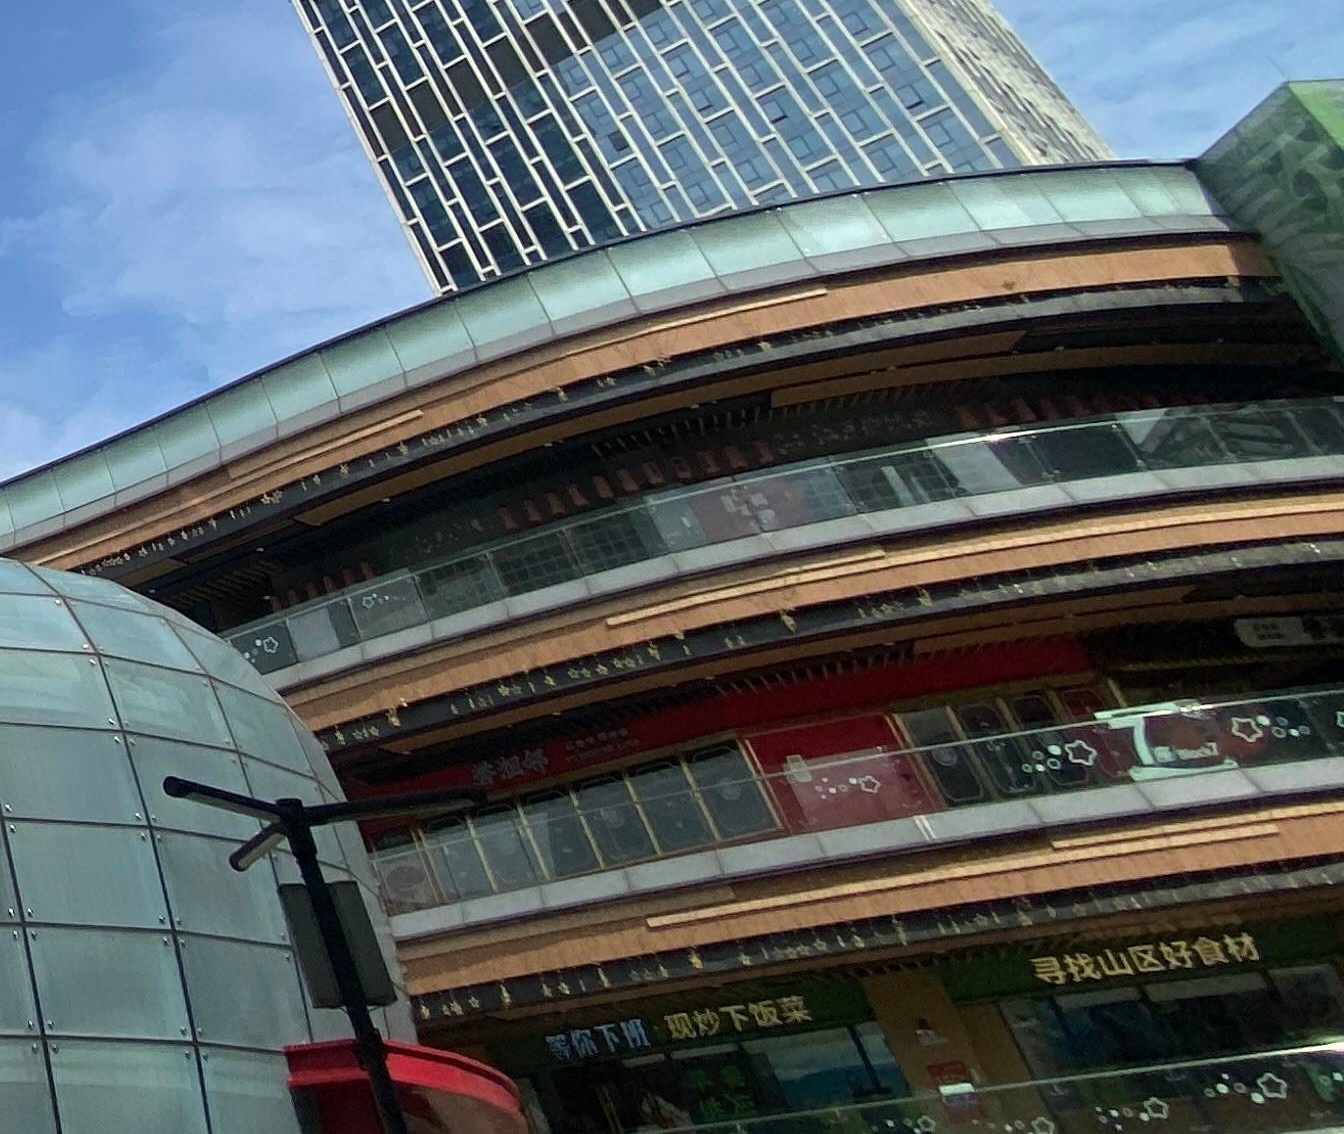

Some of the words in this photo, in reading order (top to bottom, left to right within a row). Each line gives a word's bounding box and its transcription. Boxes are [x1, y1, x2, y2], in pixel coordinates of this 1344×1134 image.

[1028, 930, 1260, 986] 寻找山区好食材
